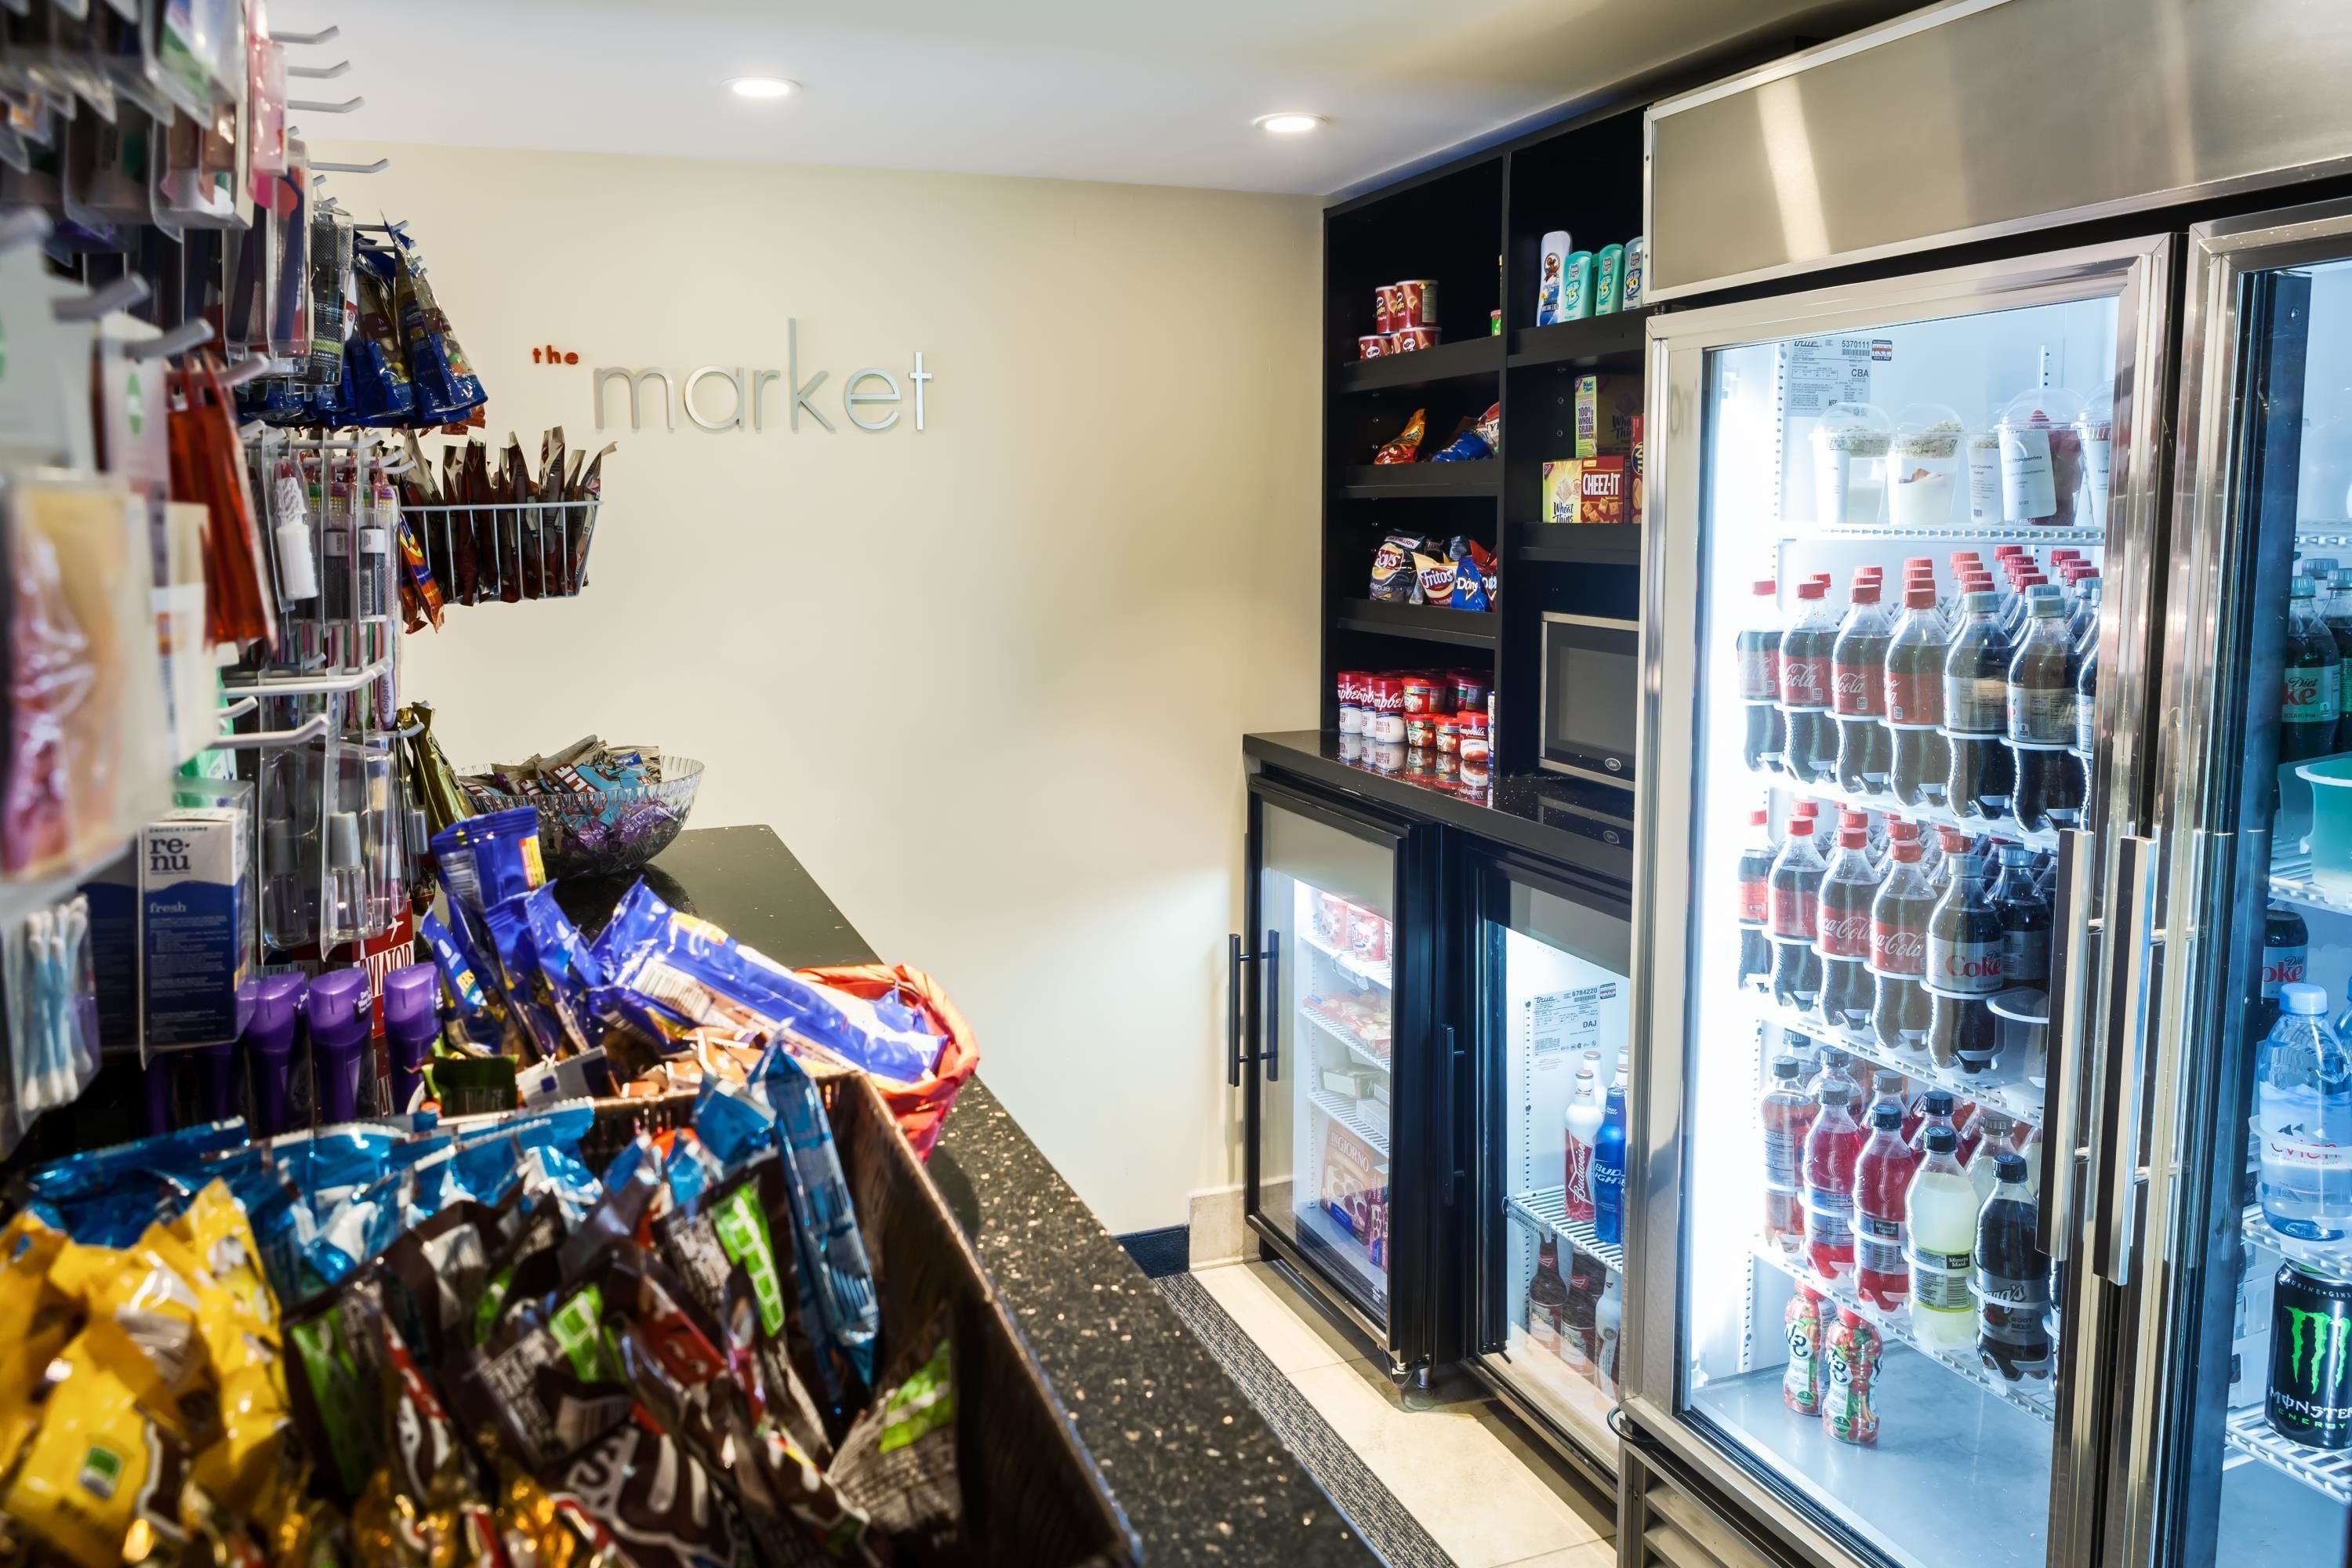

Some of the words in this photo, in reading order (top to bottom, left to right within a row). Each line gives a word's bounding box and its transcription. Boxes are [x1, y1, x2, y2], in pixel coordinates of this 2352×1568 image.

[1842, 340, 1870, 349] 5370111
[532, 345, 579, 365] the
[593, 318, 933, 431] market
[1851, 368, 1869, 377] CBA
[1583, 473, 1621, 495] CHEEZ-IT
[1553, 501, 1574, 515] Wheat
[1420, 568, 1454, 589] Fritos
[2288, 677, 2318, 688] Diet
[2283, 682, 2318, 705] ke
[150, 855, 191, 871] nu
[149, 902, 187, 913] fresh
[1572, 987, 1598, 997] 6784220
[1583, 1020, 1597, 1029] DAJ
[1595, 1162, 1621, 1176] BUD
[1595, 1173, 1622, 1185] IGHT
[2278, 1408, 2347, 1429] ENERGY
